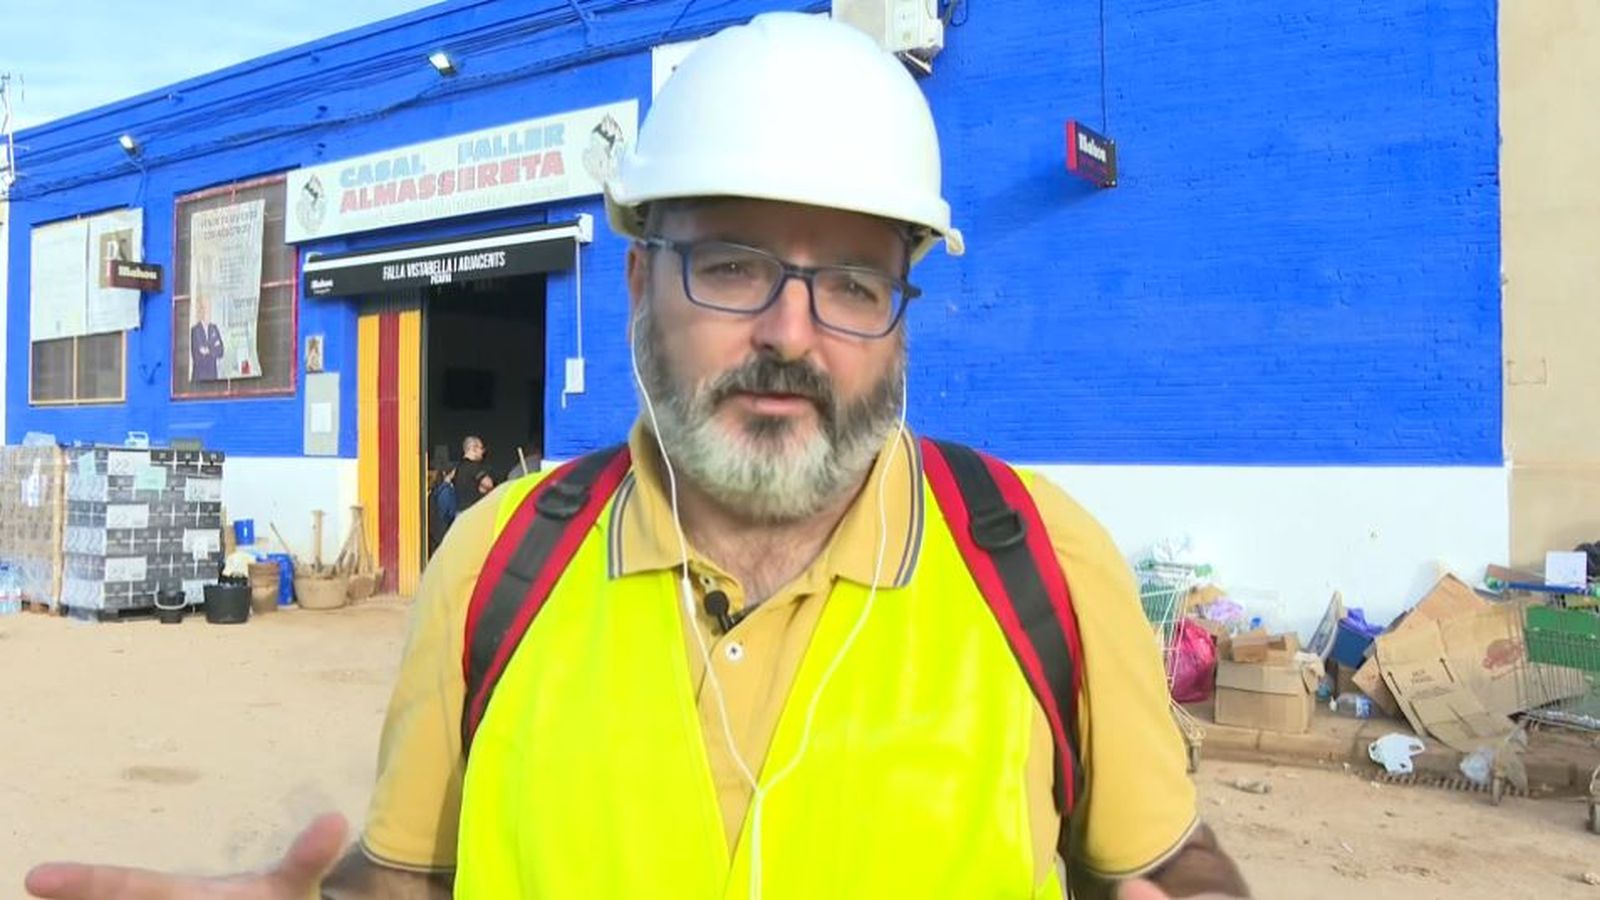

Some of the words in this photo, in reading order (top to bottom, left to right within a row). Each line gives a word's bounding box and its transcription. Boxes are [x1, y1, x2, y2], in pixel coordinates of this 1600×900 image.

[340, 150, 426, 187] CASAL
[457, 124, 566, 163] FALLER
[340, 151, 566, 214] ALMASSERETA
[383, 264, 405, 281] FALLA
